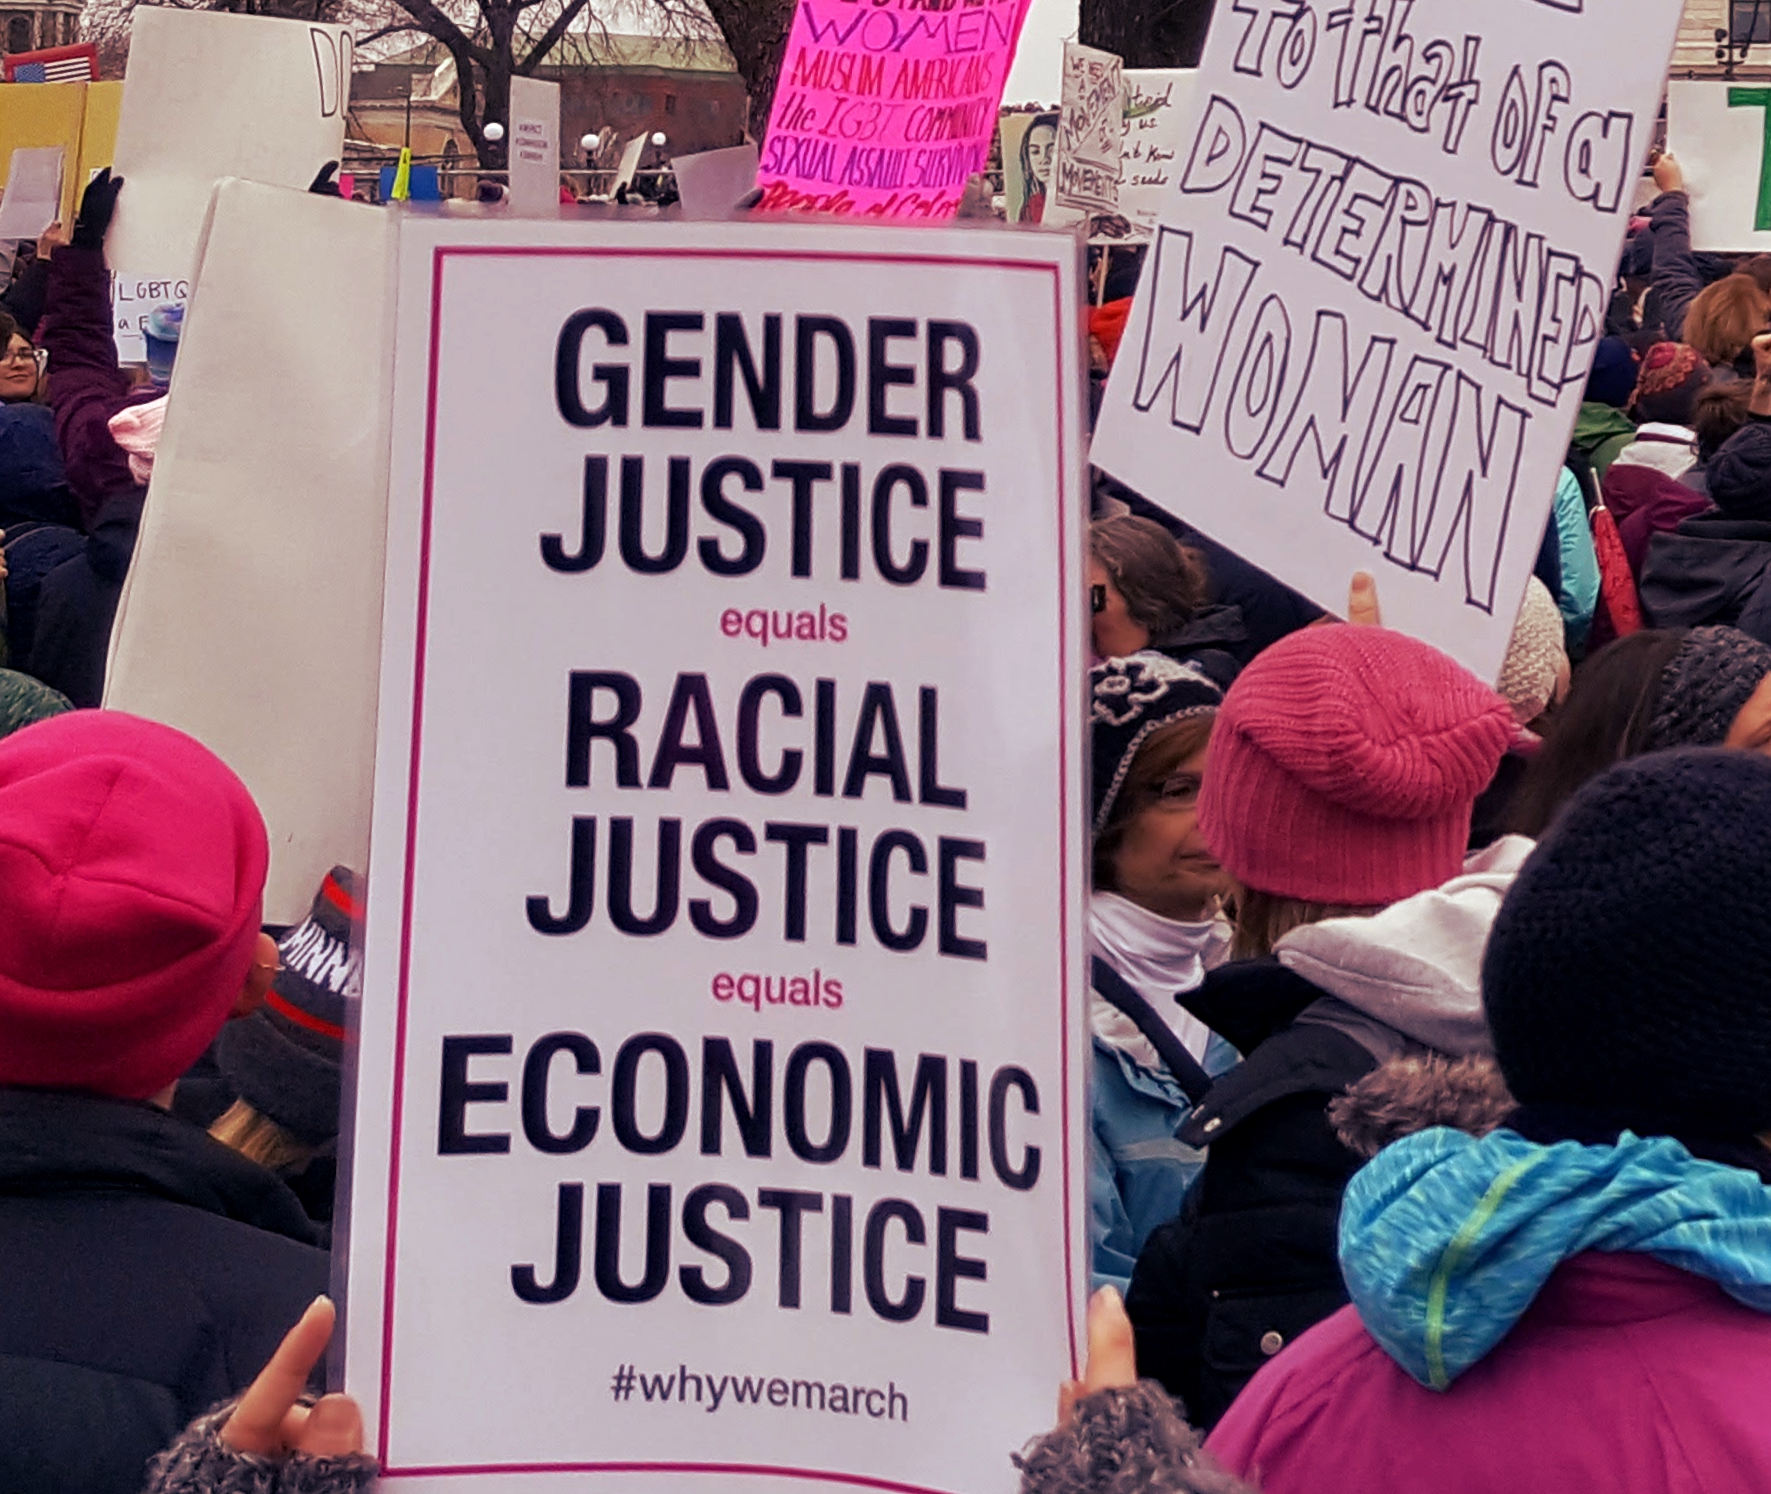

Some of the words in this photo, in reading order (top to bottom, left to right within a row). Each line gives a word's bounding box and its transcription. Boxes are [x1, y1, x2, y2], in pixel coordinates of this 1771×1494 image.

[790, 46, 885, 96] MUSLIM
[802, 1, 1016, 54] WOMEN
[760, 136, 838, 182] SEXUAL
[1181, 95, 1605, 406] DETERMINED
[554, 307, 982, 442] GENDER
[1133, 225, 1533, 614] WOMAN
[539, 454, 987, 591] JUSTICE
[720, 603, 848, 647] equals
[565, 670, 967, 810] RACIAL
[526, 815, 988, 962] JUSTICE
[712, 969, 844, 1011] equals
[437, 1032, 1042, 1191] ECONOMIC
[510, 1182, 990, 1335] JUSTICE
[611, 1364, 908, 1422] #whywemarch
